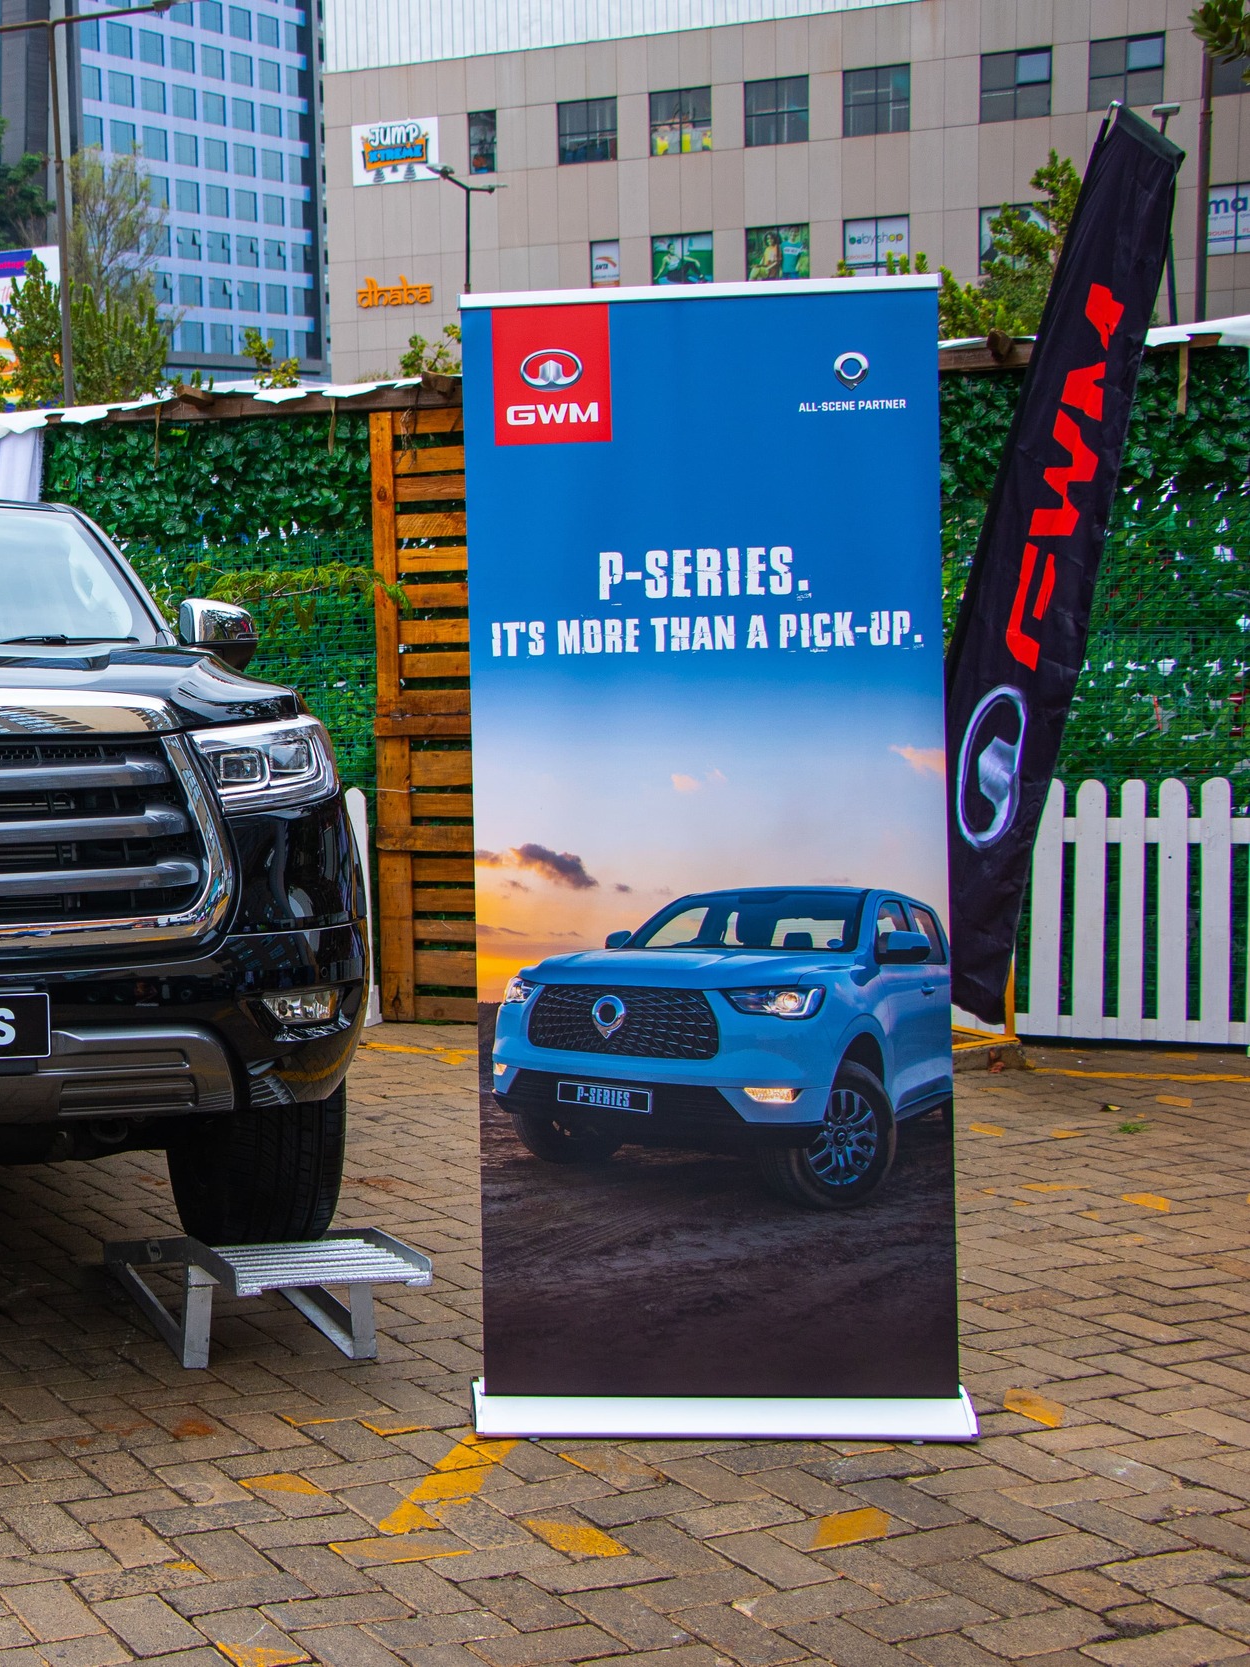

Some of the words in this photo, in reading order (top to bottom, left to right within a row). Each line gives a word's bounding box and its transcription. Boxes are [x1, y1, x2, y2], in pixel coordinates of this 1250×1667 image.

[369, 123, 421, 148] JUMP
[1208, 196, 1248, 214] ma
[849, 231, 904, 246] babyshop
[357, 274, 433, 308] dhaba
[506, 402, 599, 426] GWM
[798, 400, 856, 413] ALL-SCENE
[858, 399, 907, 411] PARTNER
[599, 546, 810, 601] P-SERIES.
[491, 621, 546, 658] IT'S
[557, 617, 640, 656] MORE
[650, 615, 735, 654] THAN
[746, 616, 769, 652] A
[779, 610, 923, 652] PICK-UP.
[576, 1086, 630, 1108] P-SERIES
